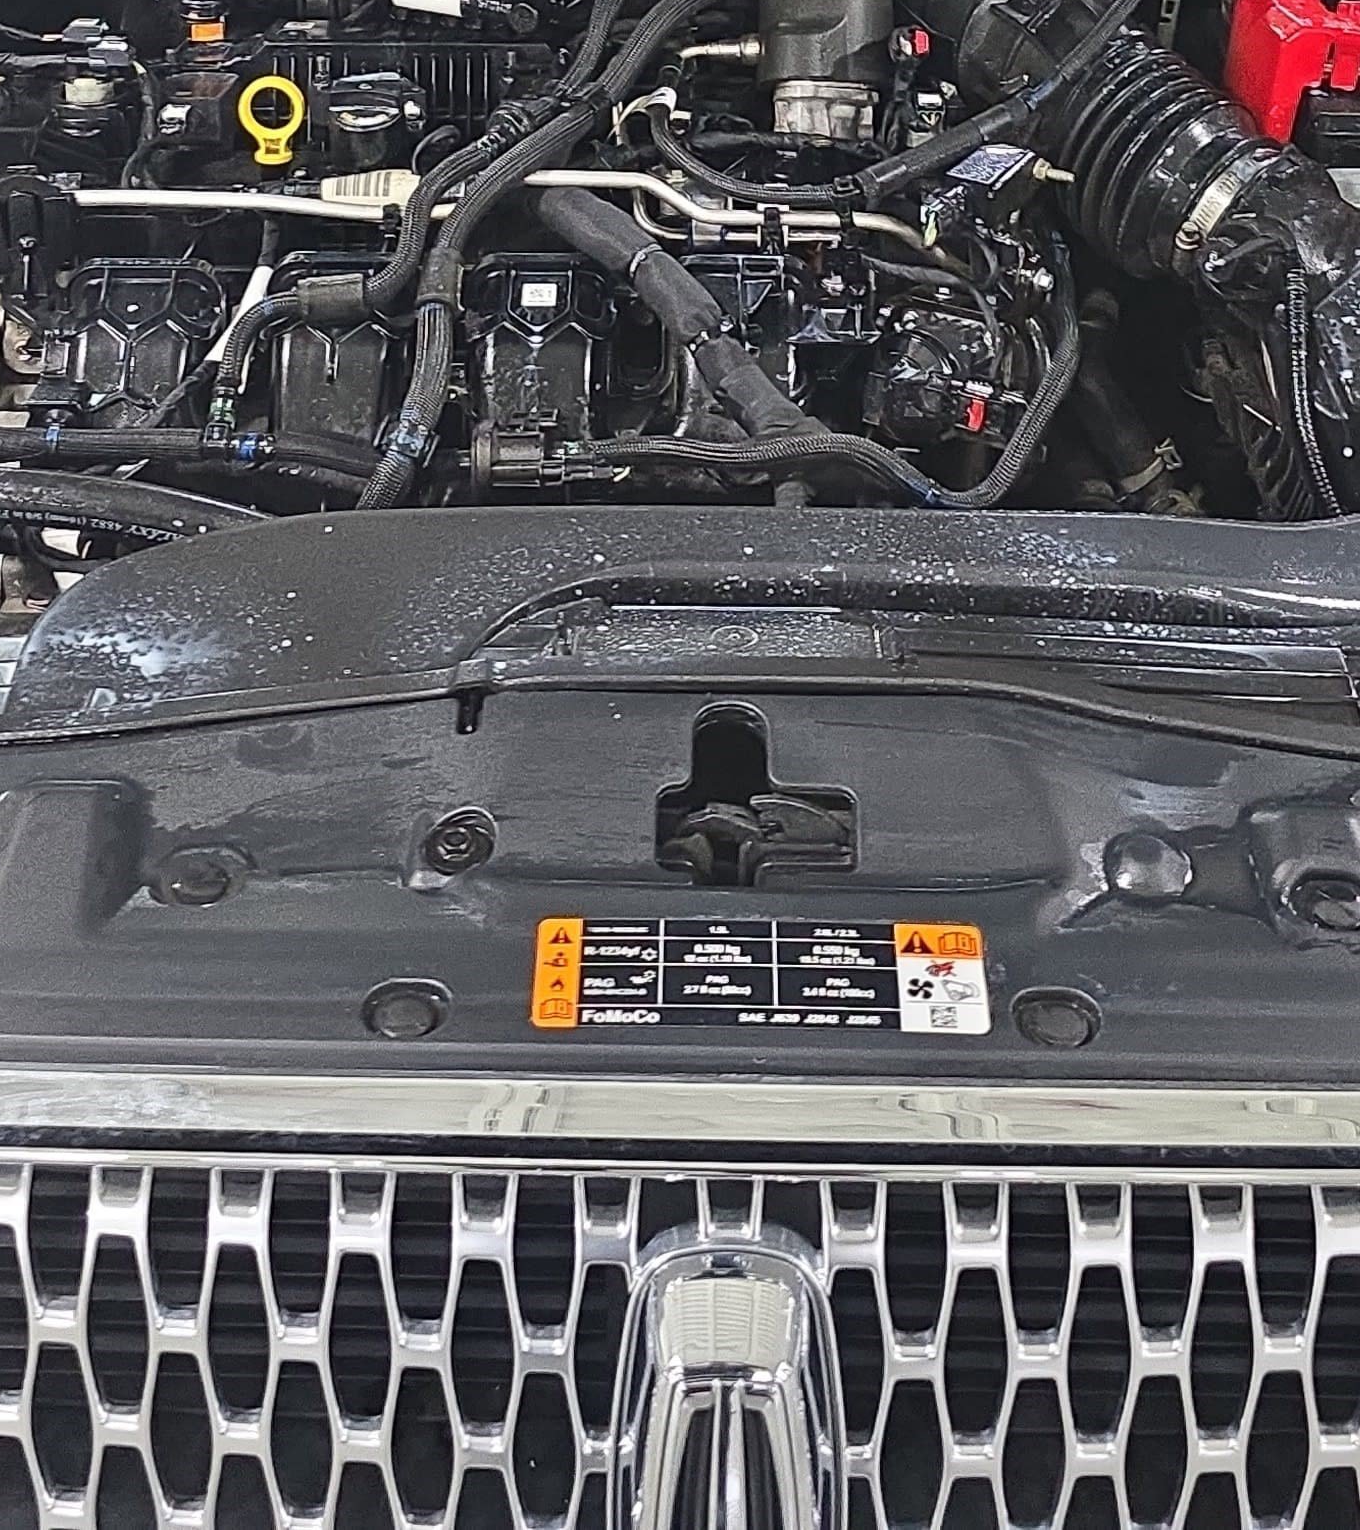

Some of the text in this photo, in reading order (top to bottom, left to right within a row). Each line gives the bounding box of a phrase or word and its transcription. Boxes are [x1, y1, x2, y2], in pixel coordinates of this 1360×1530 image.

[90, 517, 123, 532] 4882
[583, 977, 616, 988] PAG
[581, 1009, 661, 1024] FoMoCo
[738, 1012, 767, 1023] SAE
